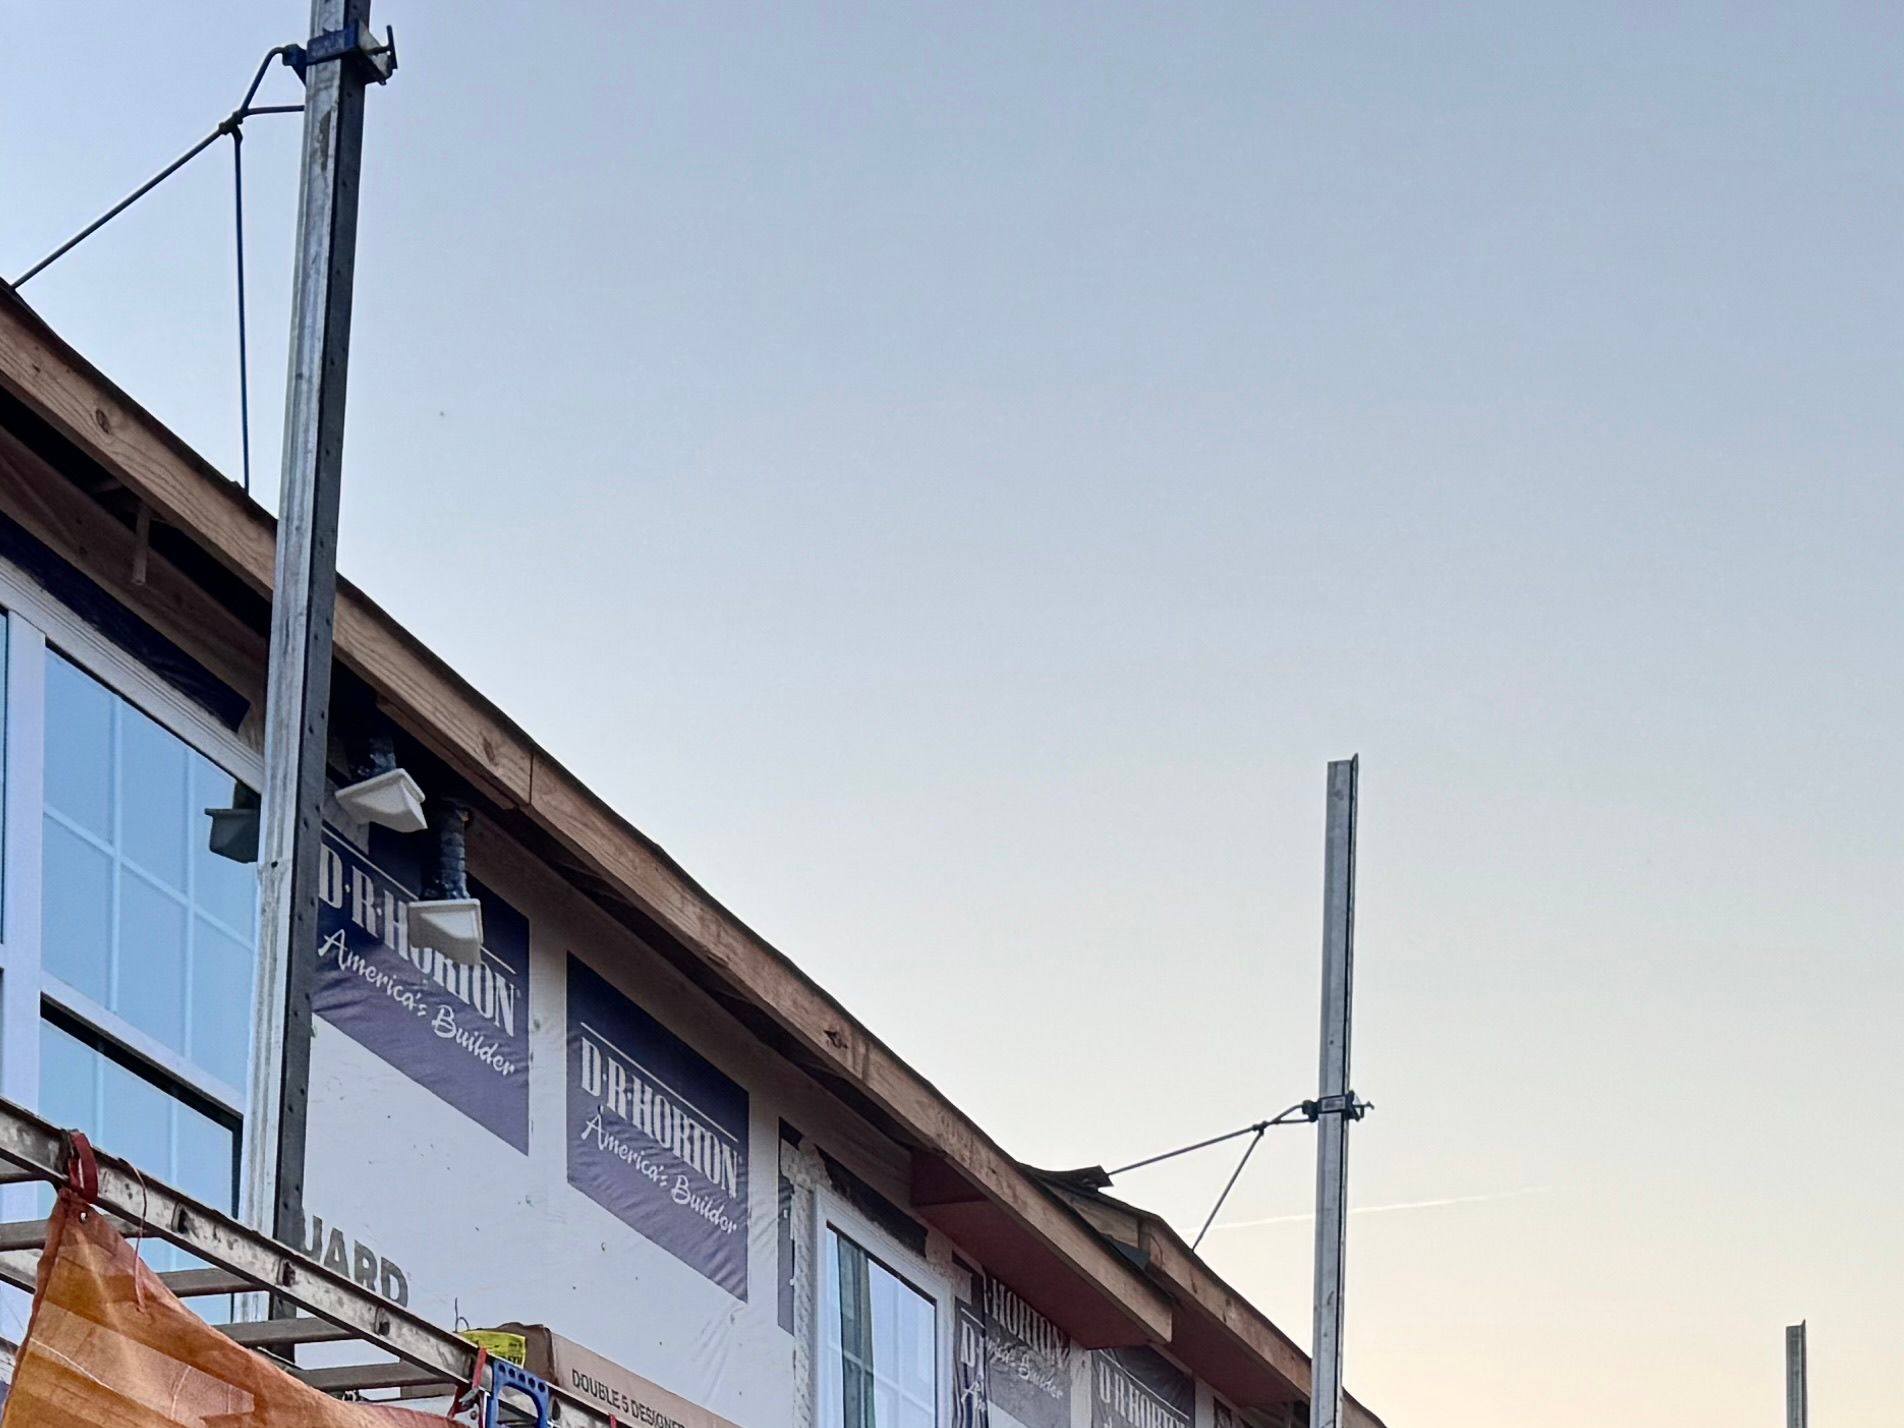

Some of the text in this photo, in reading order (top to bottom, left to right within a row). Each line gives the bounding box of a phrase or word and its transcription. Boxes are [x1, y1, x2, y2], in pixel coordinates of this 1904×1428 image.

[317, 928, 516, 1078] America's Builder
[580, 1110, 669, 1189] America's
[299, 1200, 409, 1308] UARD
[571, 1367, 621, 1412] DOUBLE
